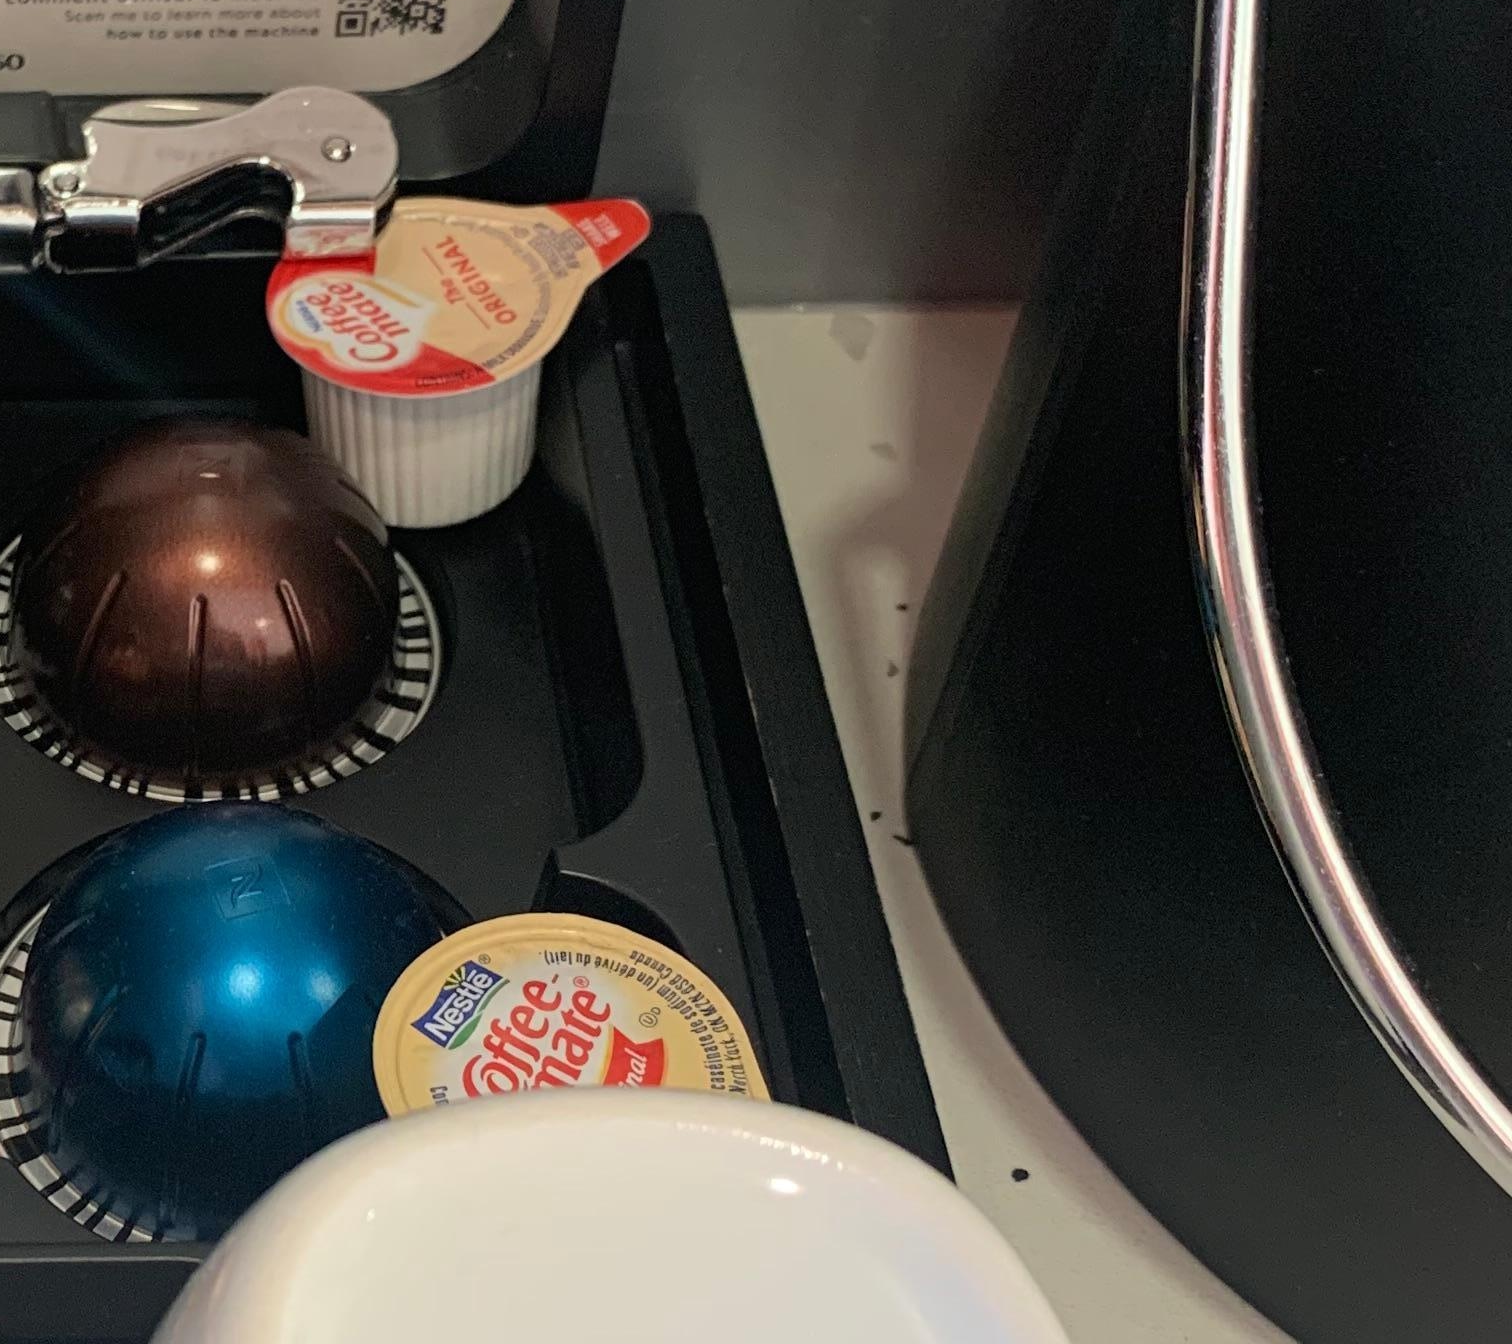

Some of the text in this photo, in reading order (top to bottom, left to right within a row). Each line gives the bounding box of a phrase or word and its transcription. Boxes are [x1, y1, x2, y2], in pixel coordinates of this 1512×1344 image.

[435, 235, 517, 325] ORIGINAL
[440, 278, 460, 305] The
[308, 292, 399, 363] Coffee
[575, 951, 592, 966] du
[594, 955, 638, 979] dérivé
[656, 985, 698, 1021] sodium
[691, 1017, 709, 1034] de
[698, 1035, 726, 1090] caséinate
